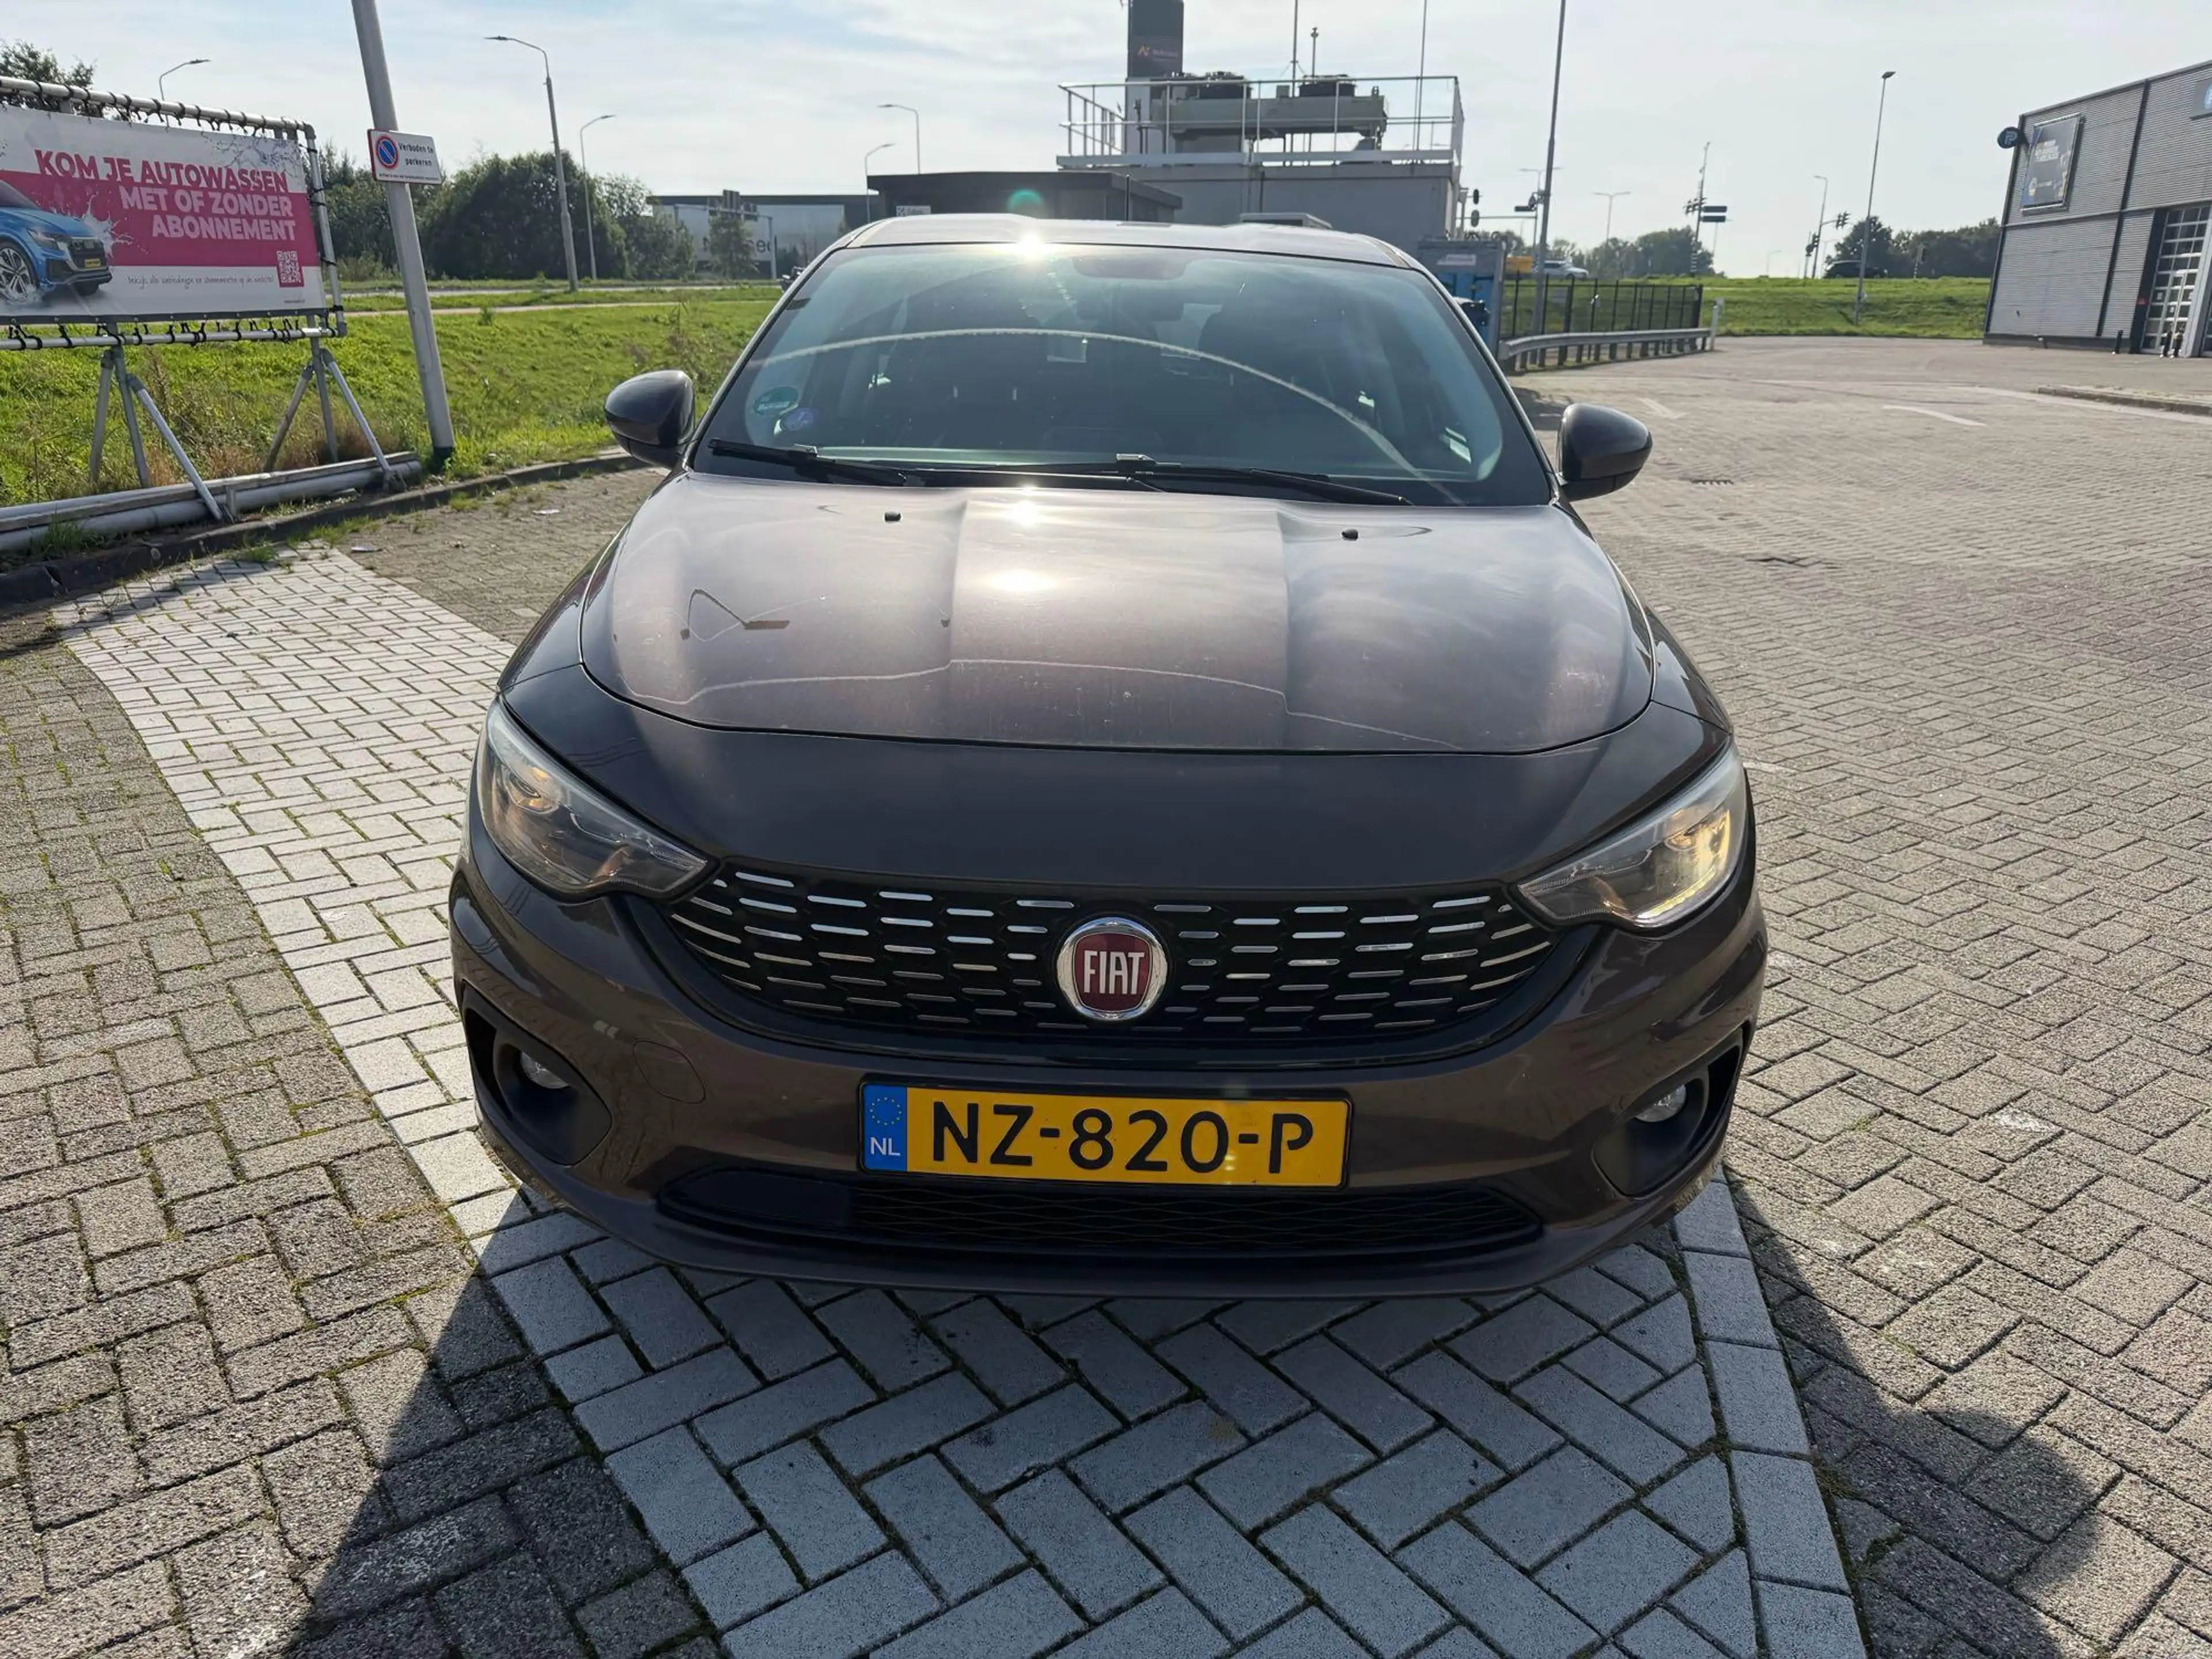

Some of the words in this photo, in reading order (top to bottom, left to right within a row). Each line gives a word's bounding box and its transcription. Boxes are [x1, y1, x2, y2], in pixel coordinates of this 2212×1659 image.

[398, 142, 426, 153] Verboden
[427, 145, 434, 153] te
[405, 157, 432, 166] parkeren
[35, 149, 99, 180] KOM
[103, 157, 134, 185] JE
[141, 160, 287, 194] AUTOWASSEN
[119, 185, 168, 211] MET
[175, 189, 204, 213] OF
[209, 191, 293, 217] ZONDER
[152, 215, 296, 241] ABONNEMENT
[1084, 950, 1146, 995] FIAT
[870, 1137, 901, 1157] NL
[933, 1101, 1313, 1173] NZ-820-P
